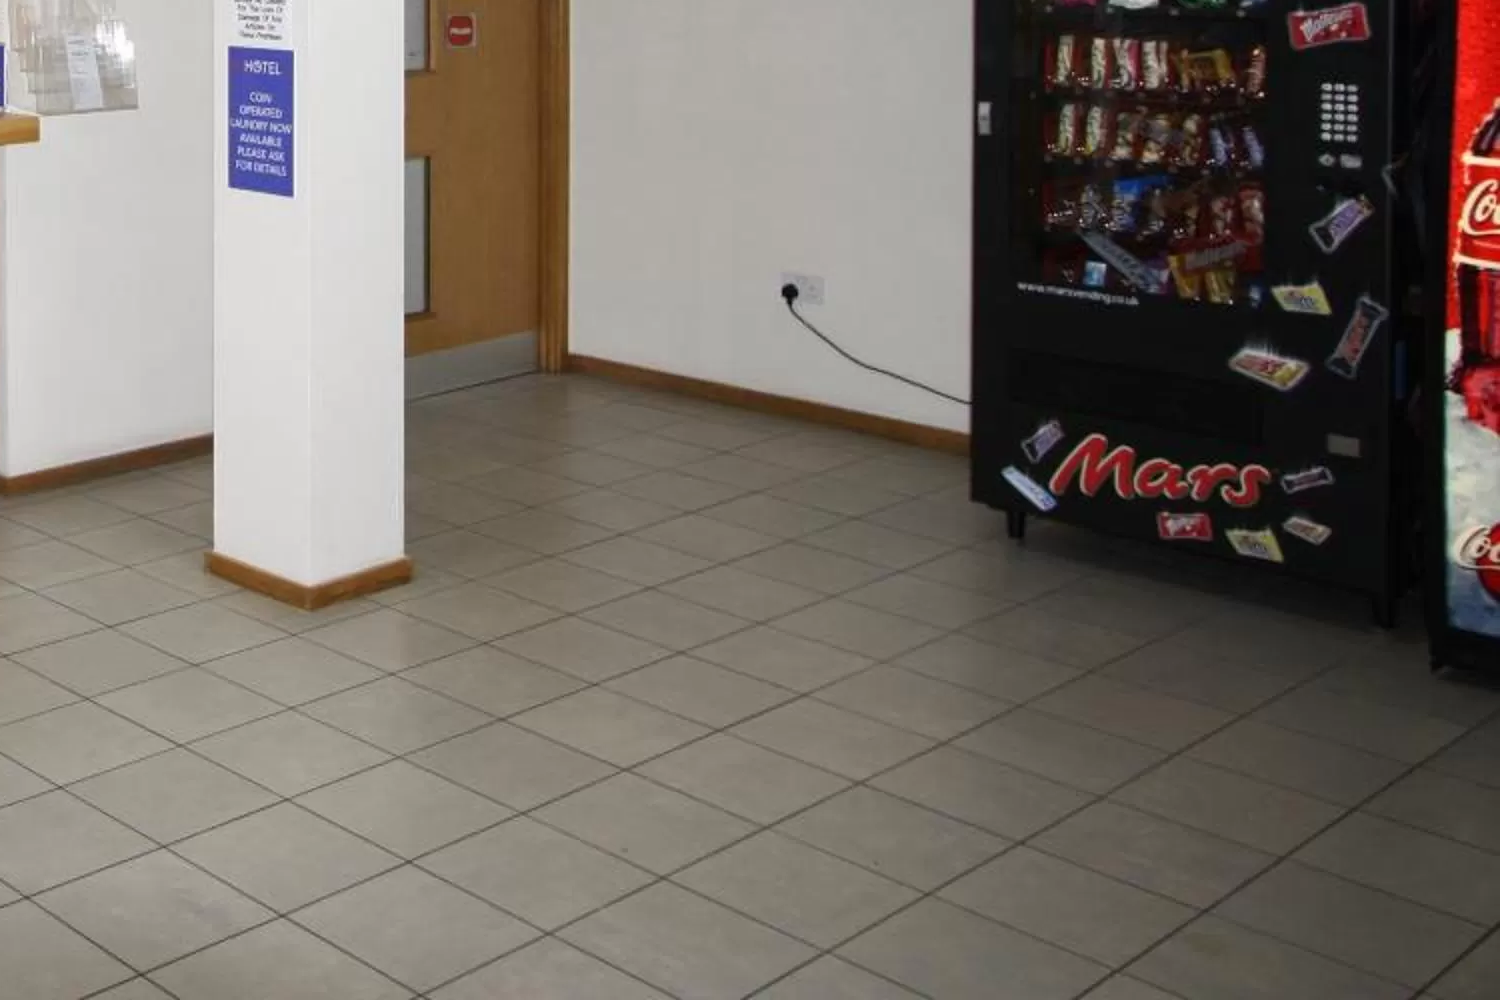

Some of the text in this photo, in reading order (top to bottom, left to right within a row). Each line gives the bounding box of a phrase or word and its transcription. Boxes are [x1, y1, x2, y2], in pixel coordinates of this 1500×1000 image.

[243, 59, 282, 75] HOTEL
[249, 91, 272, 104] COIN
[239, 104, 283, 119] OPERATED
[269, 122, 293, 135] NOW
[237, 145, 285, 162] PLEASE ASK
[235, 159, 252, 172] FOR
[1048, 433, 1271, 507] Mars
